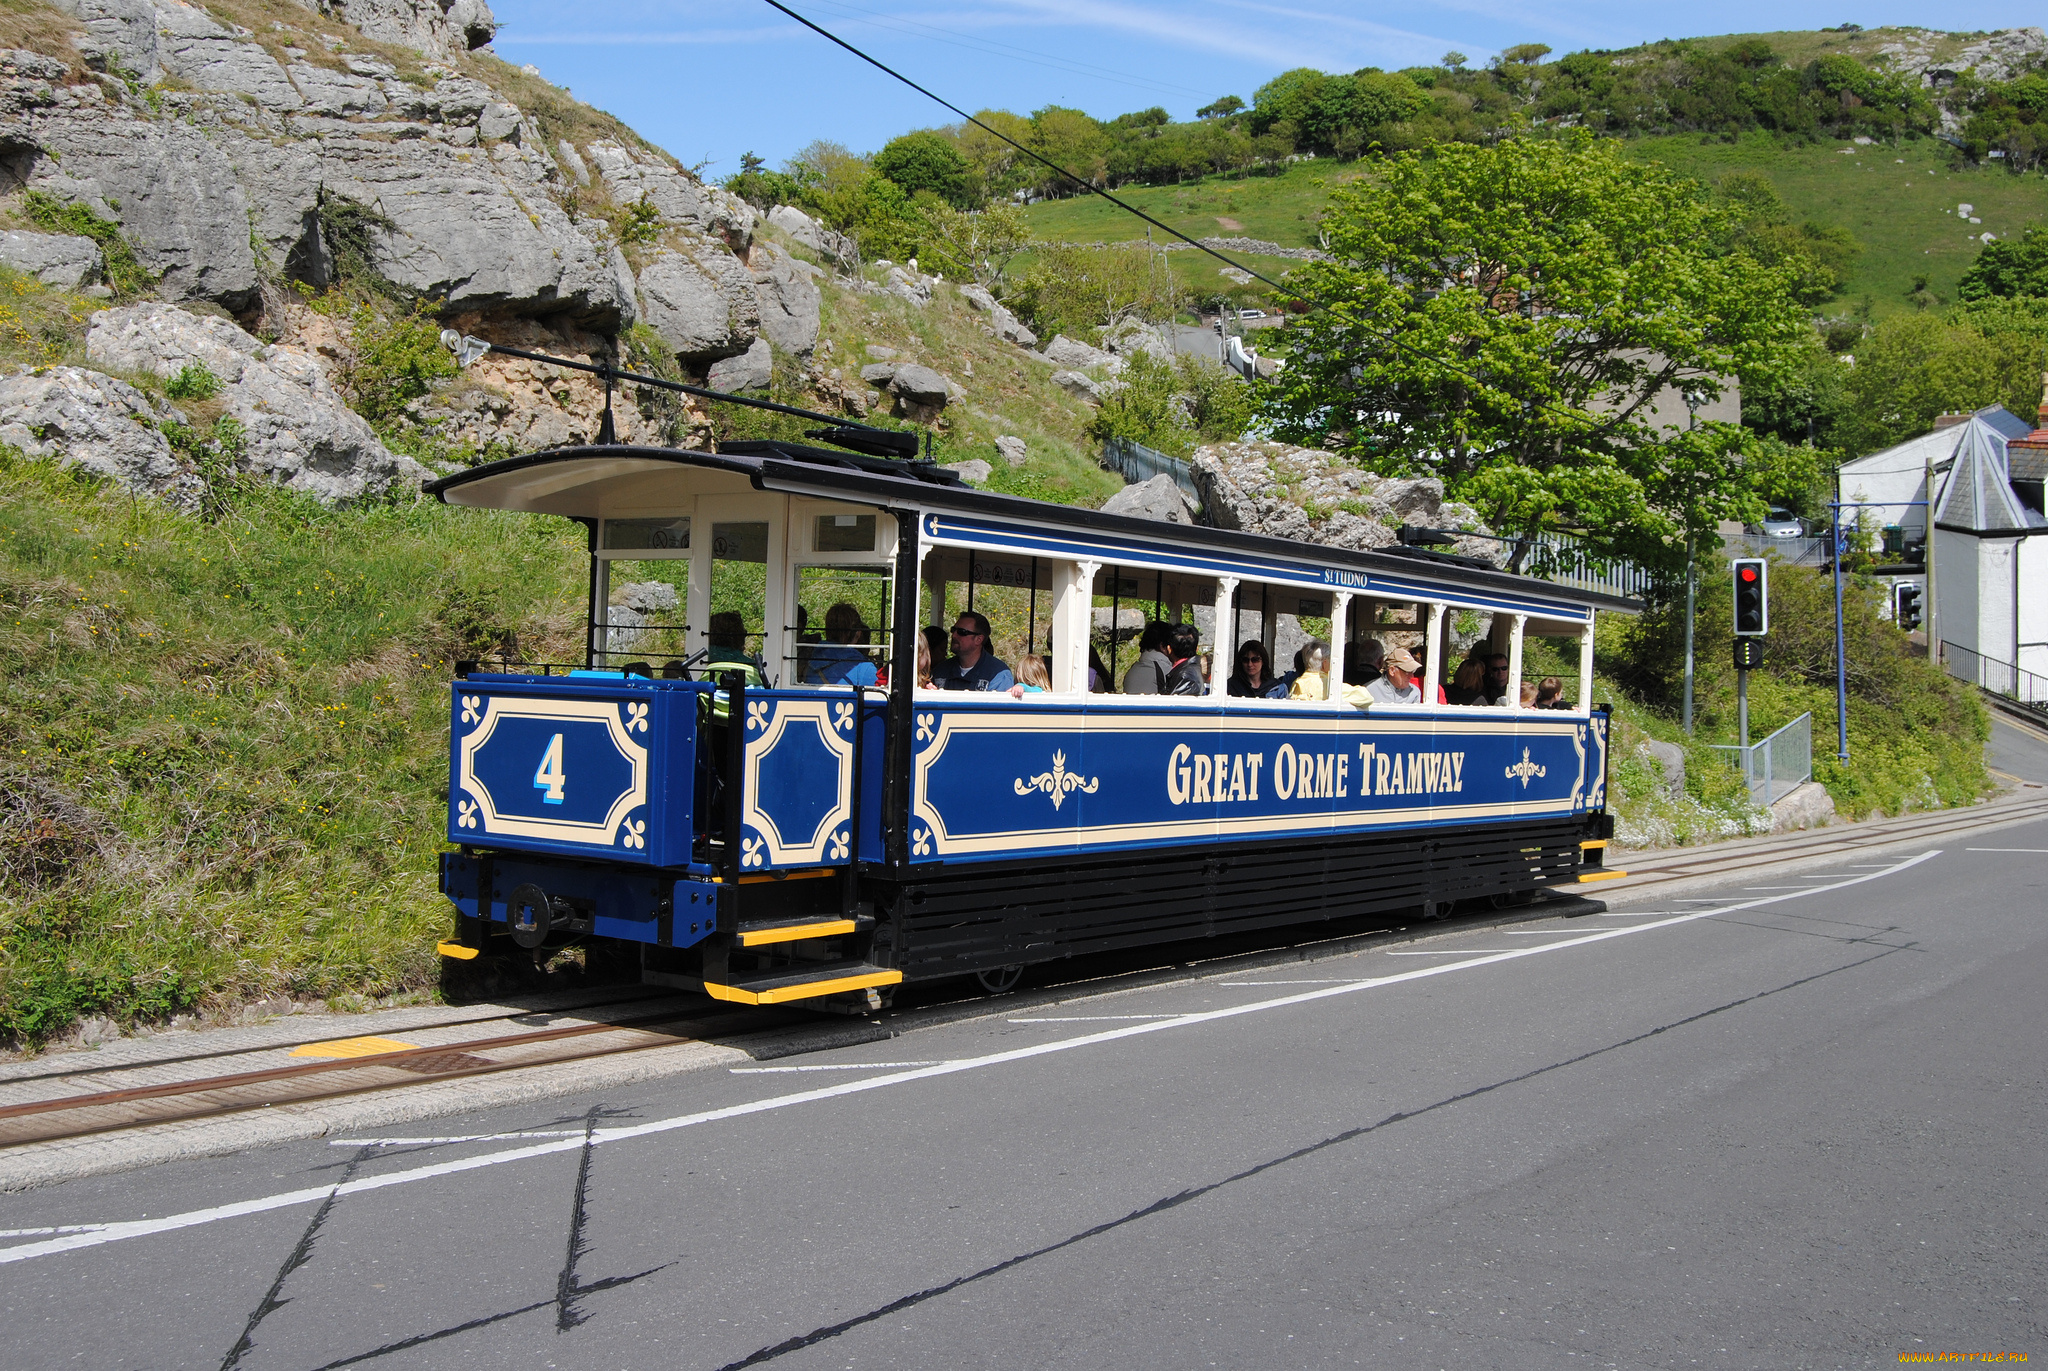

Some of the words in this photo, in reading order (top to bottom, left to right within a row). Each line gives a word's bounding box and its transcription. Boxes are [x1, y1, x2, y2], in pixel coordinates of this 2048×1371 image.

[1335, 571, 1368, 588] TUDNO
[533, 733, 566, 805] 4
[1167, 743, 1263, 806] GREAT
[1274, 742, 1349, 800] ORME
[1359, 742, 1465, 796] TRAMWAY
